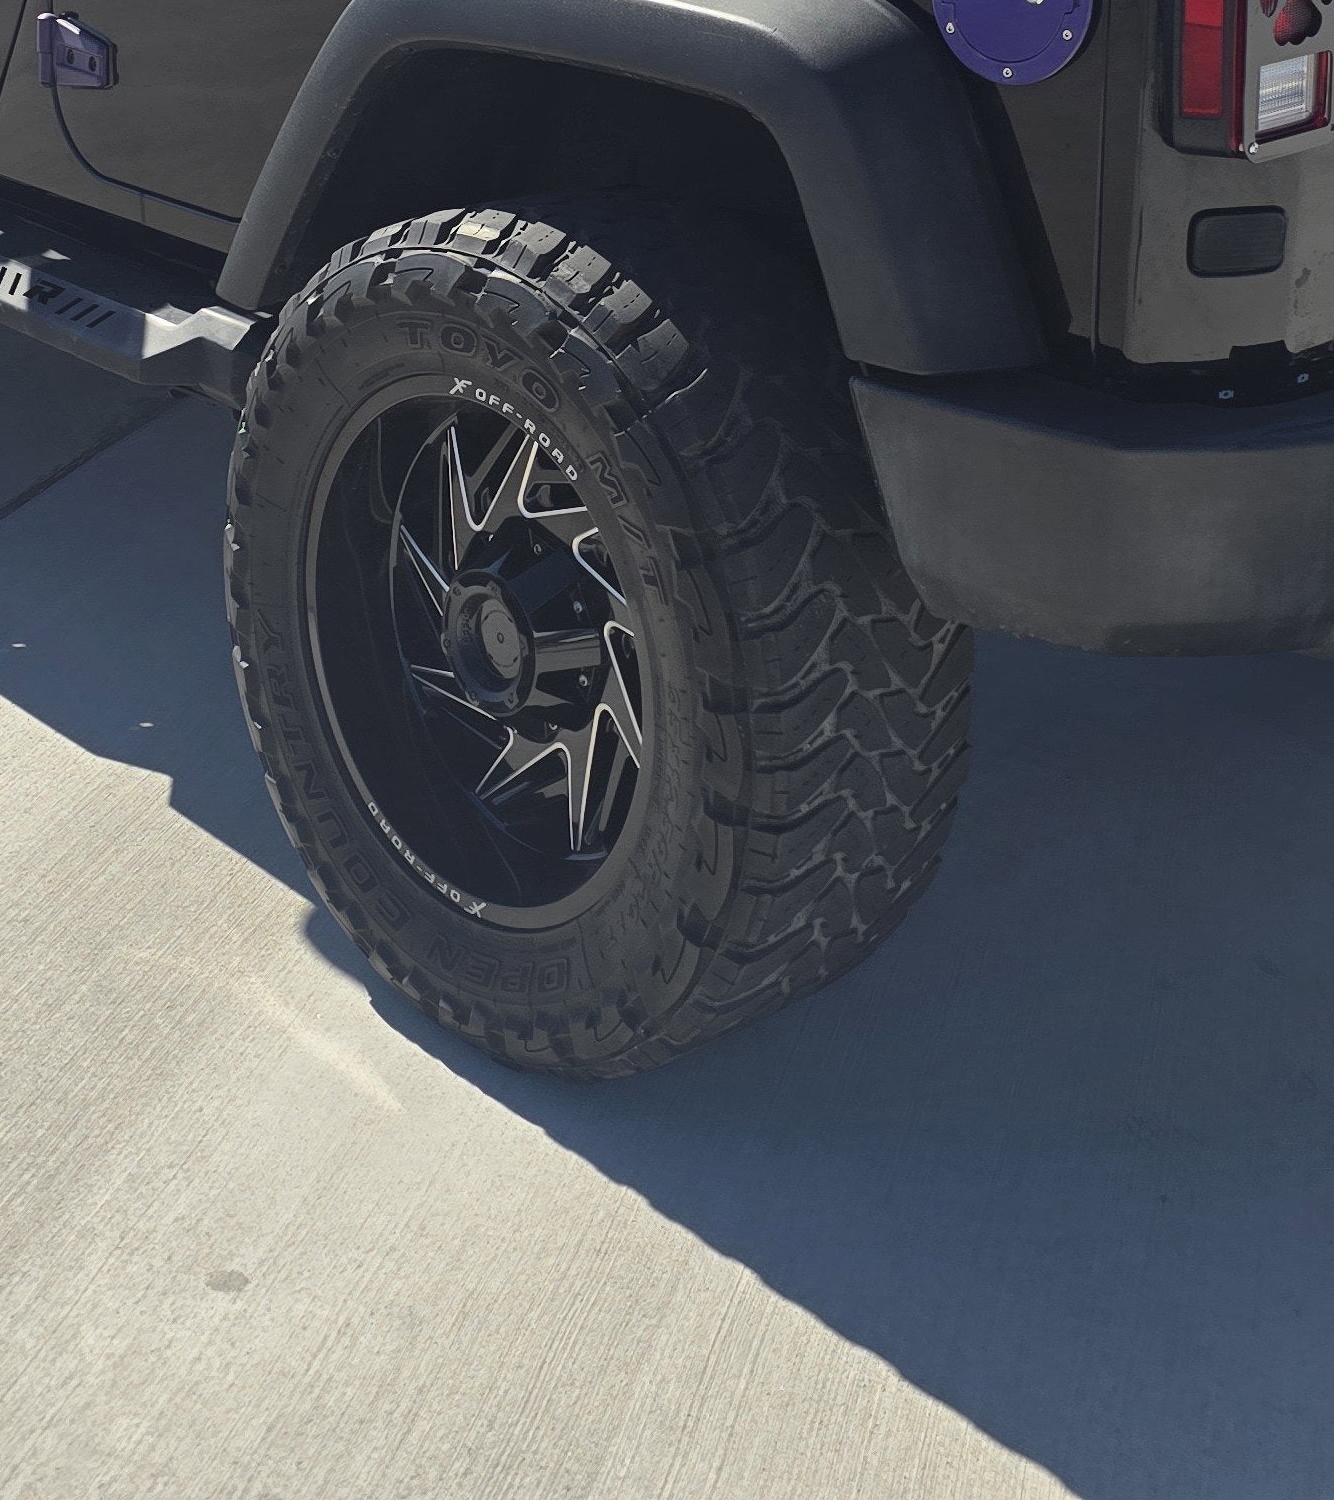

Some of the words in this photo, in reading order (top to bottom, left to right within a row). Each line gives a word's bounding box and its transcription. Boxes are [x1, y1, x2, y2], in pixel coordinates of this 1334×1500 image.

[396, 317, 560, 413] TOYO
[475, 388, 578, 482] OFF-ROAD
[586, 451, 666, 605] M/T
[251, 607, 413, 933] COUNTRY
[367, 801, 461, 902] OFF-ROAD
[426, 934, 570, 995] OPEN
